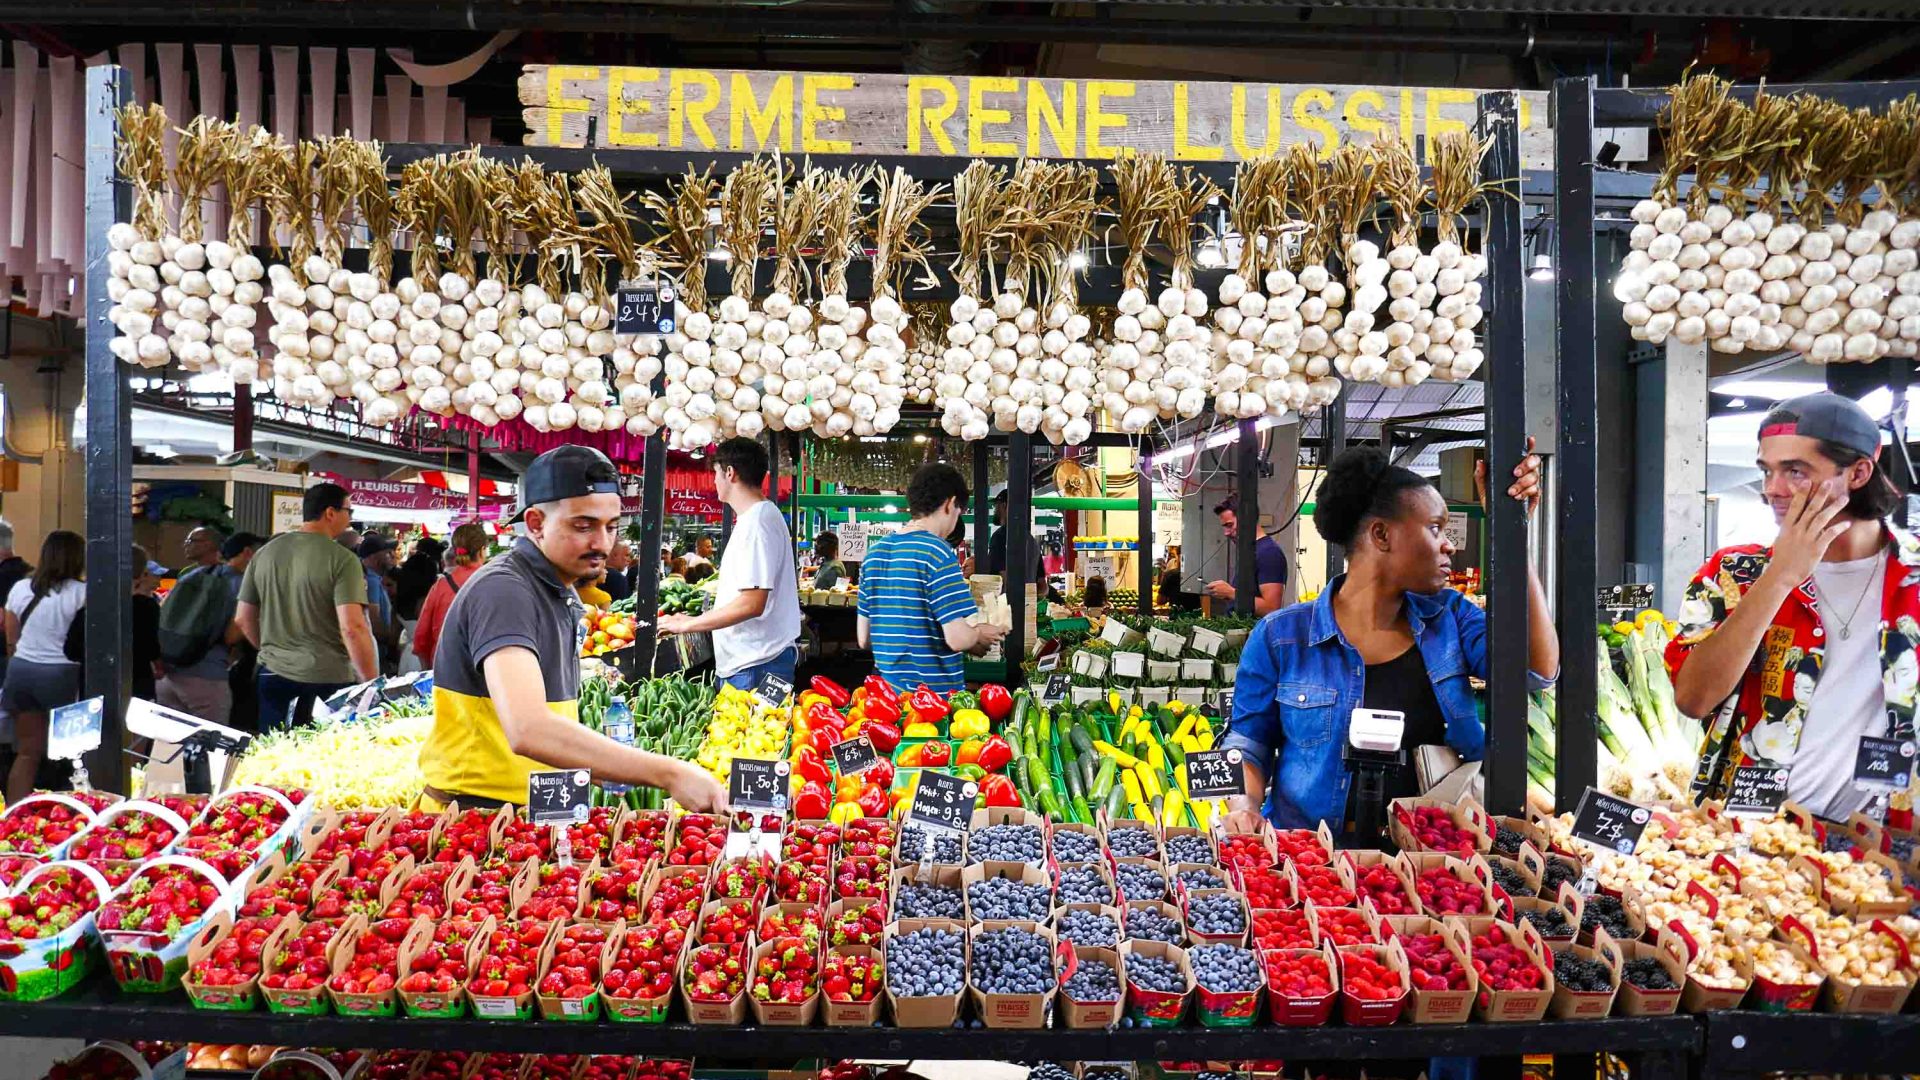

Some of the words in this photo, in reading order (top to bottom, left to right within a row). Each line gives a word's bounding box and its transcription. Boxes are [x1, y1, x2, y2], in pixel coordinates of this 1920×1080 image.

[546, 66, 856, 154] FERME
[907, 76, 1136, 159] RENE
[352, 481, 416, 494] FLEURISTE
[350, 491, 375, 505] Chez
[376, 495, 418, 509] Daniel
[672, 501, 695, 512] Chez
